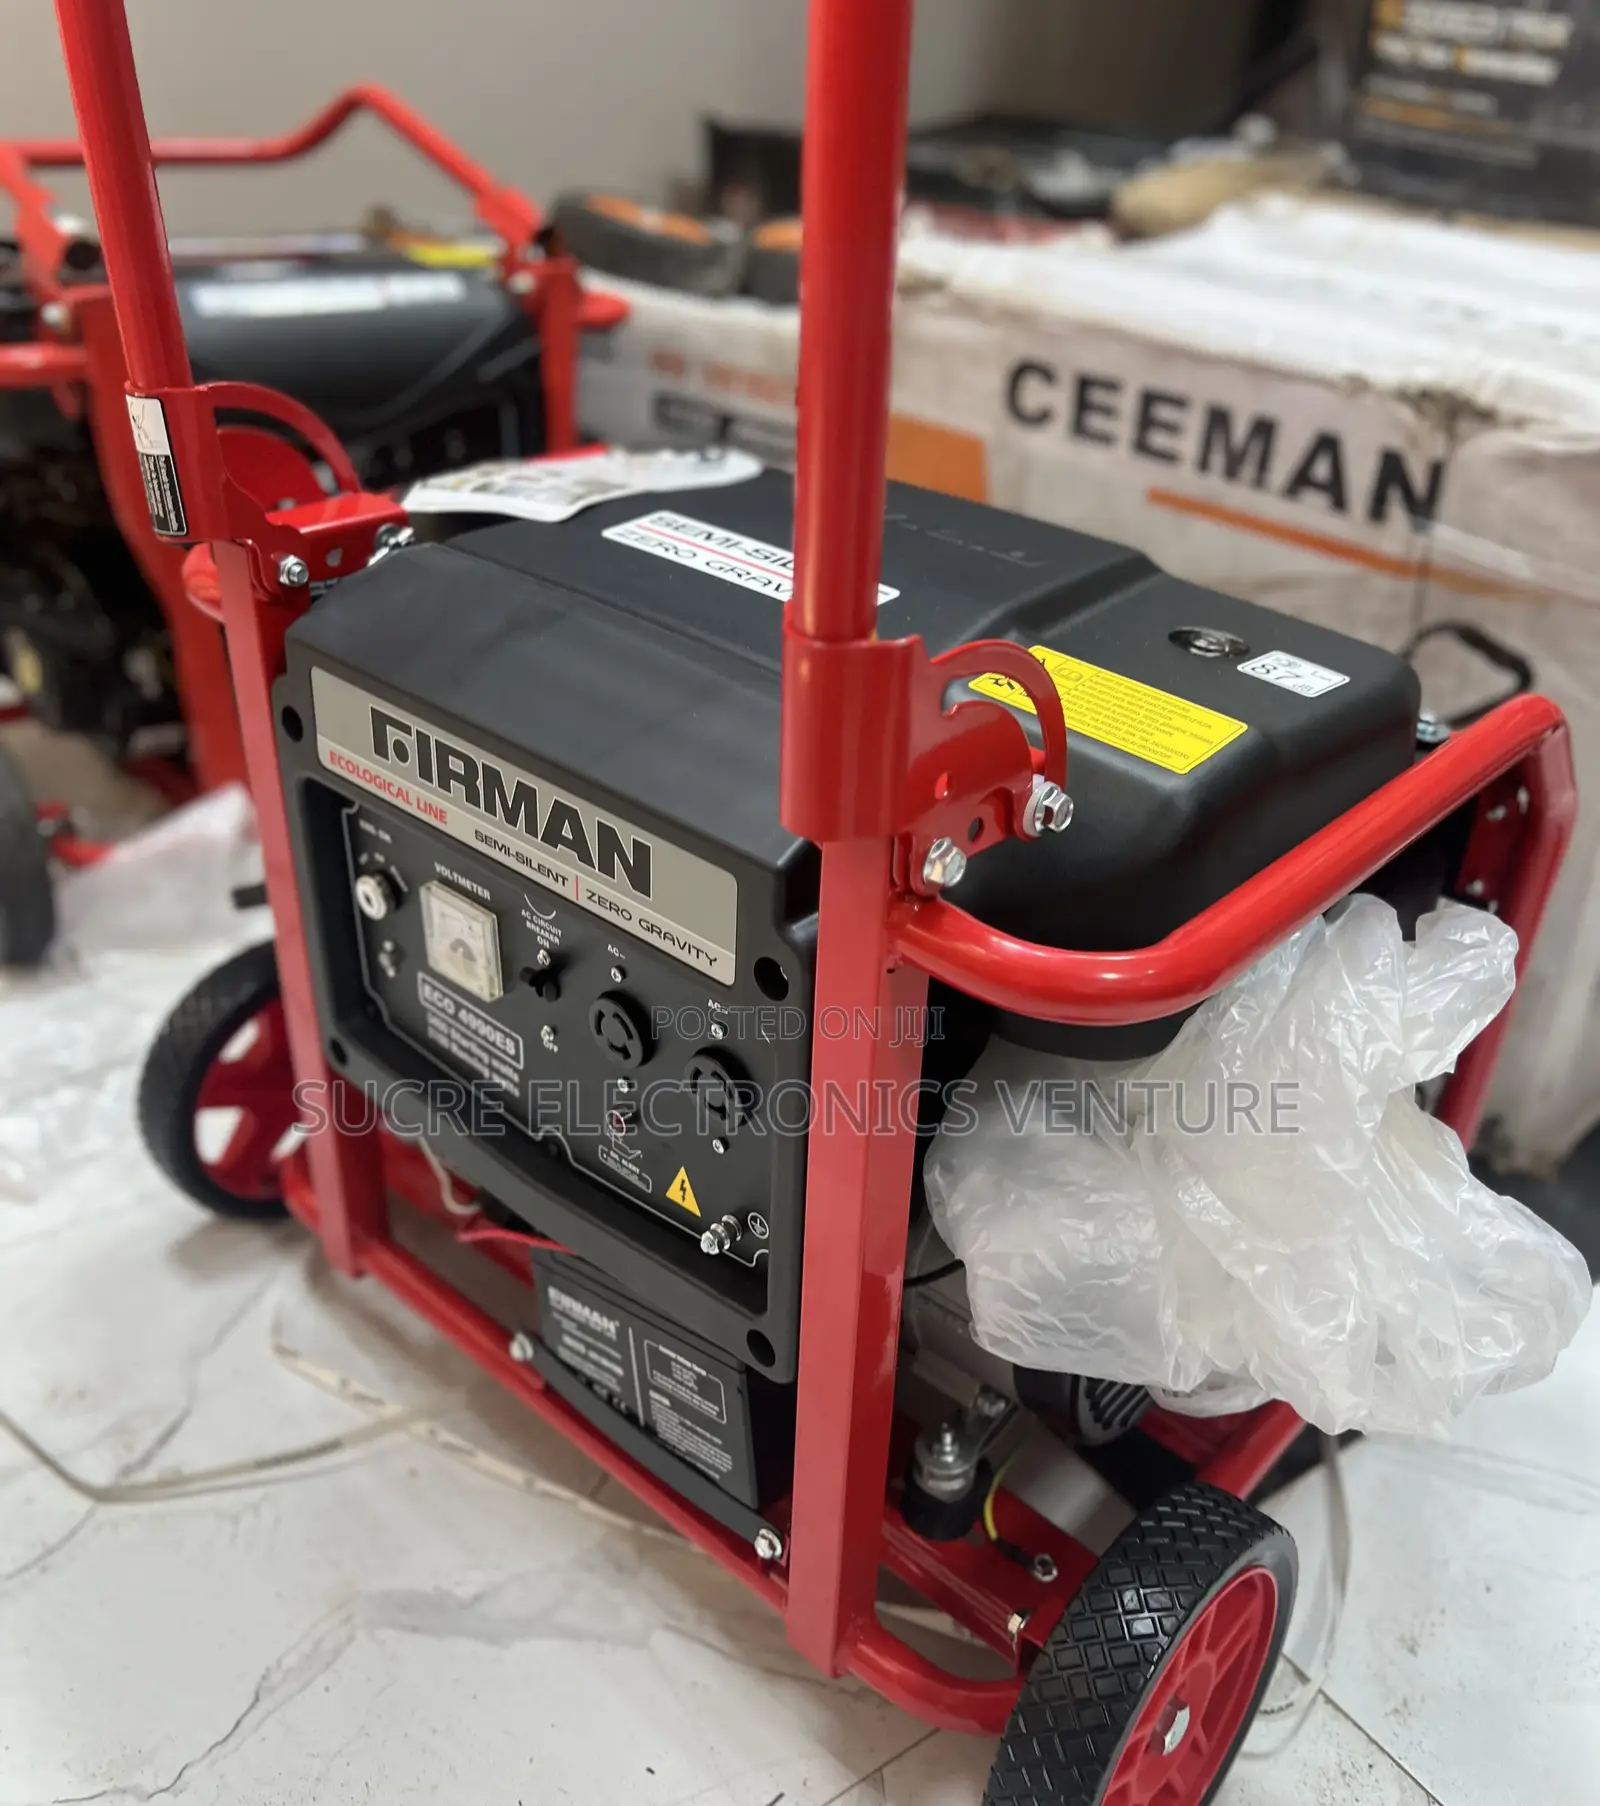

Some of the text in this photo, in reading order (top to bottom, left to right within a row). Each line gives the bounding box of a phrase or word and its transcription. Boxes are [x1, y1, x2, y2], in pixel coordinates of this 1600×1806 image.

[1006, 359, 1445, 533] CEEMAN
[615, 529, 793, 594] ZERO GRAV
[1251, 663, 1304, 681] 87
[329, 750, 447, 825] ECOLOGICAL LINE
[369, 703, 652, 899] FIRMAN
[434, 861, 491, 901] VOLTMETER
[474, 829, 718, 967] SEMI-SILENT ZERO GRAVITY
[521, 908, 563, 937] AC CIRCUIT
[526, 920, 560, 946] BREAKER
[537, 936, 550, 949] ON
[423, 983, 455, 1016] ECO
